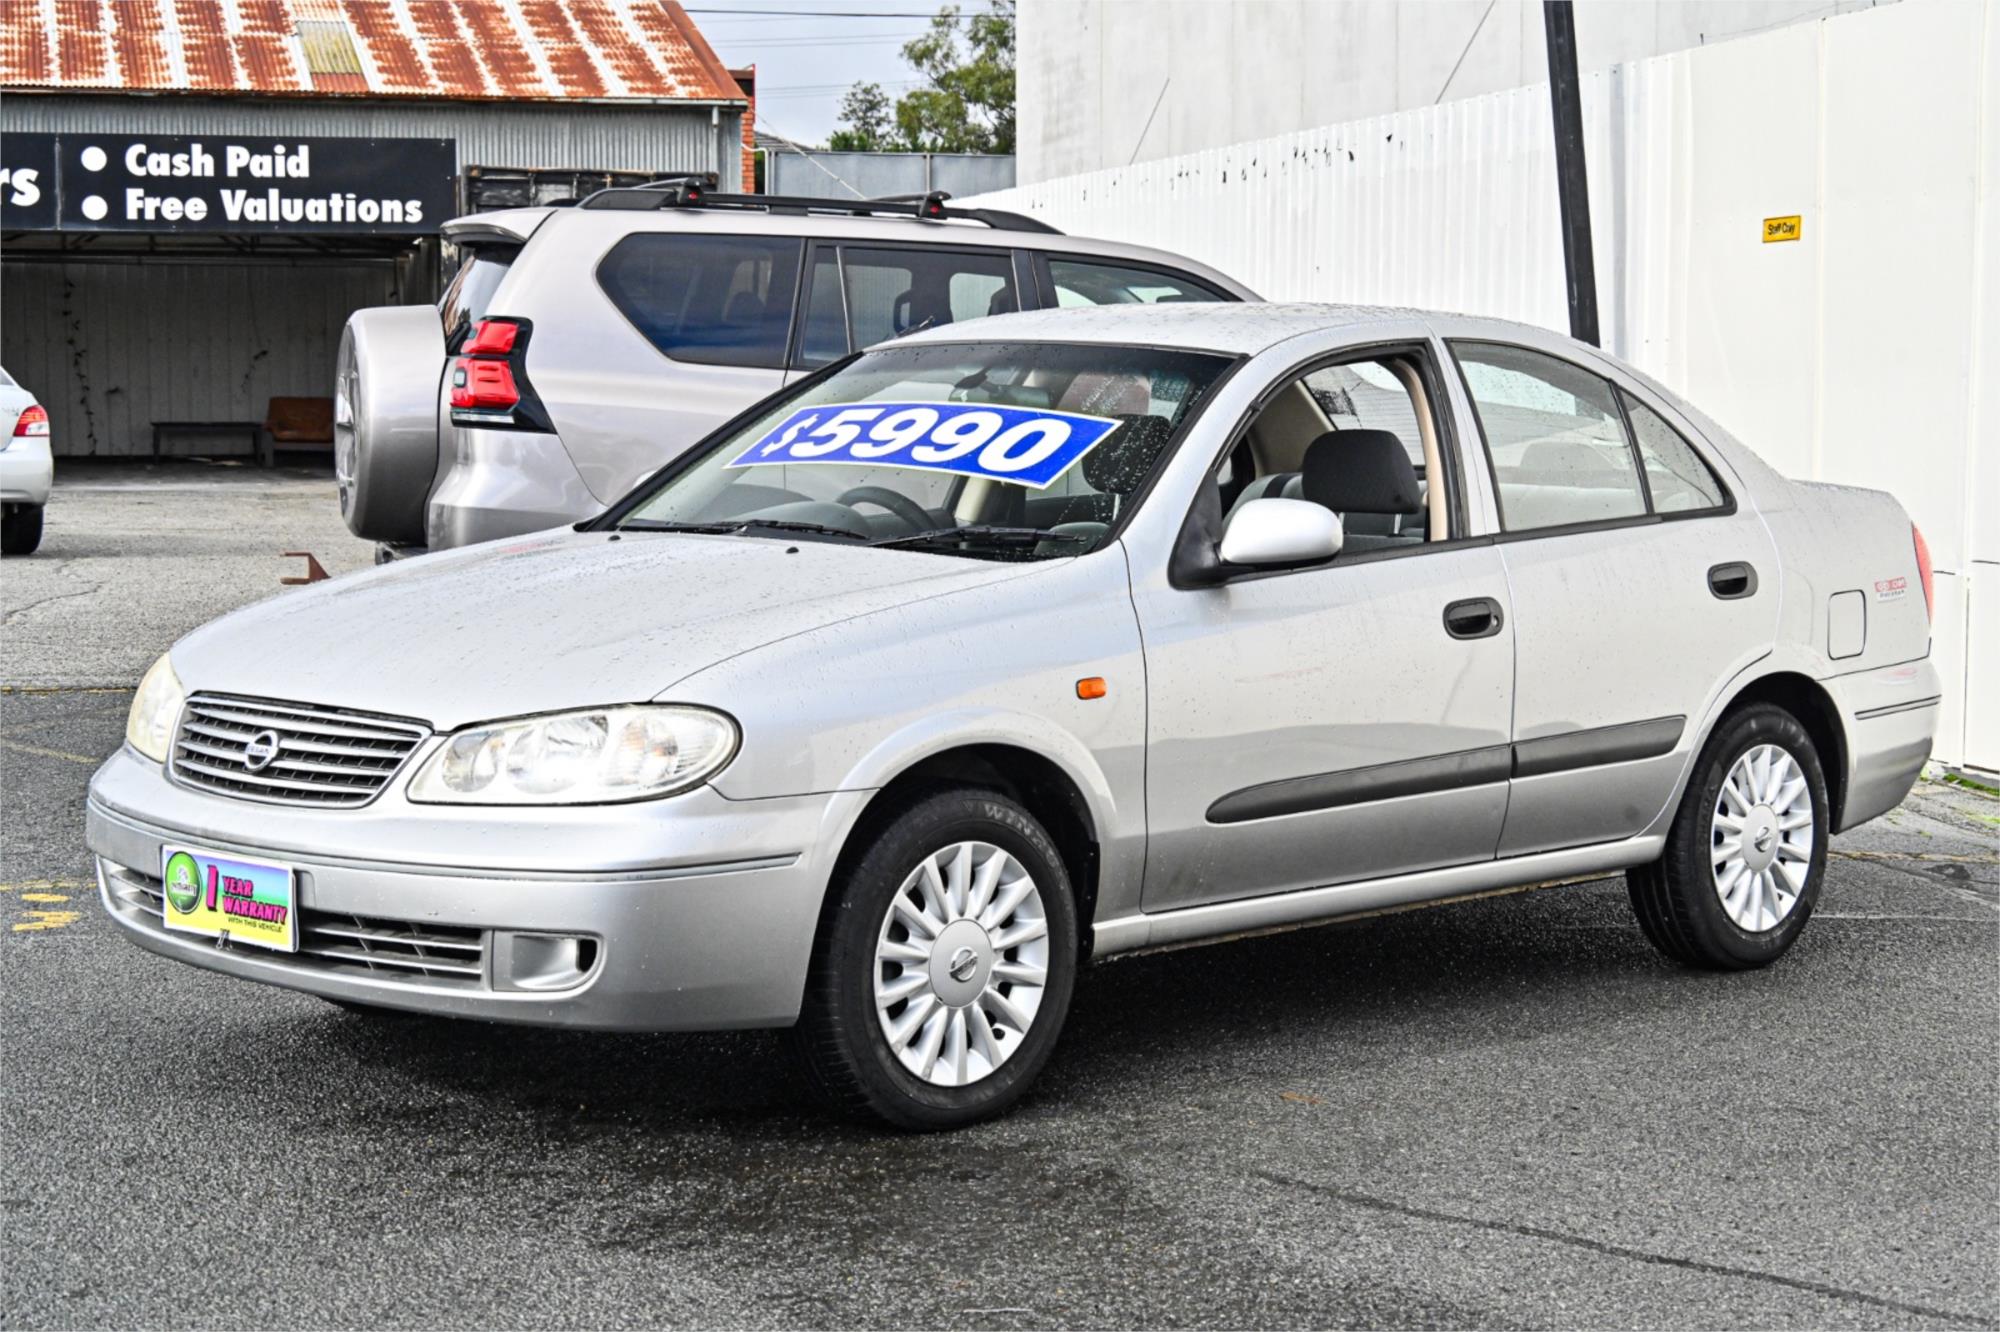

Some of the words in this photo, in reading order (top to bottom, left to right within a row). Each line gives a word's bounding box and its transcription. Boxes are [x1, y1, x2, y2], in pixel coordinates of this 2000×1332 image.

[125, 143, 215, 178] Cash
[226, 144, 310, 178] Paid
[125, 188, 208, 221] Free
[220, 189, 424, 223] Valuations
[761, 408, 1072, 472] $5990
[205, 864, 220, 912] 1
[222, 876, 254, 898] YEAR
[222, 896, 288, 925] WARRANTY
[228, 916, 243, 925] WITH
[243, 919, 256, 928] THIS
[258, 922, 282, 933] VEHICLE
